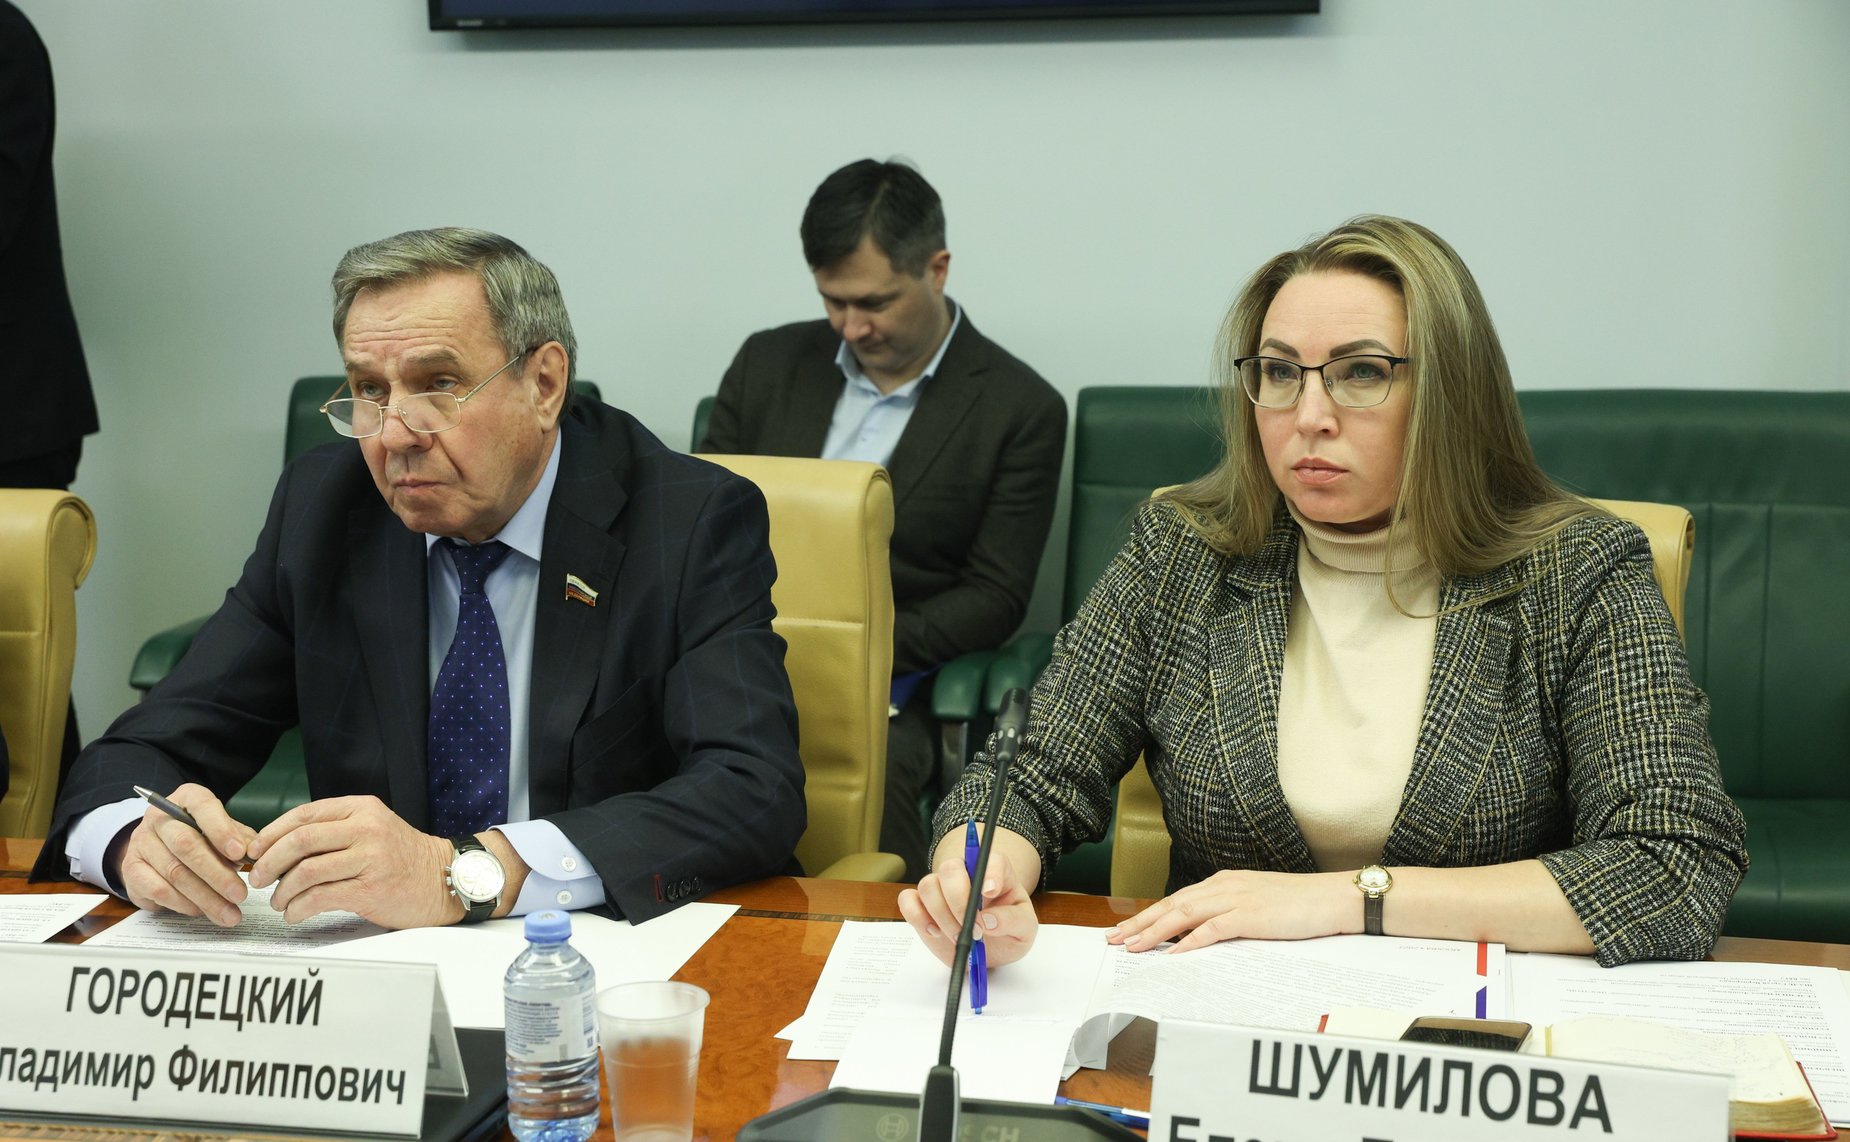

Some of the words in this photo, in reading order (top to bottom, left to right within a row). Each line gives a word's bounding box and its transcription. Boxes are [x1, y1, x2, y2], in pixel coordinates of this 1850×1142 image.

[65, 965, 325, 1031] ГОРОДЕЦКИЙ
[0, 1045, 156, 1102] ладимир
[168, 1044, 407, 1105] Филиппович
[1248, 1038, 1614, 1133] ШУМИЛОВА
